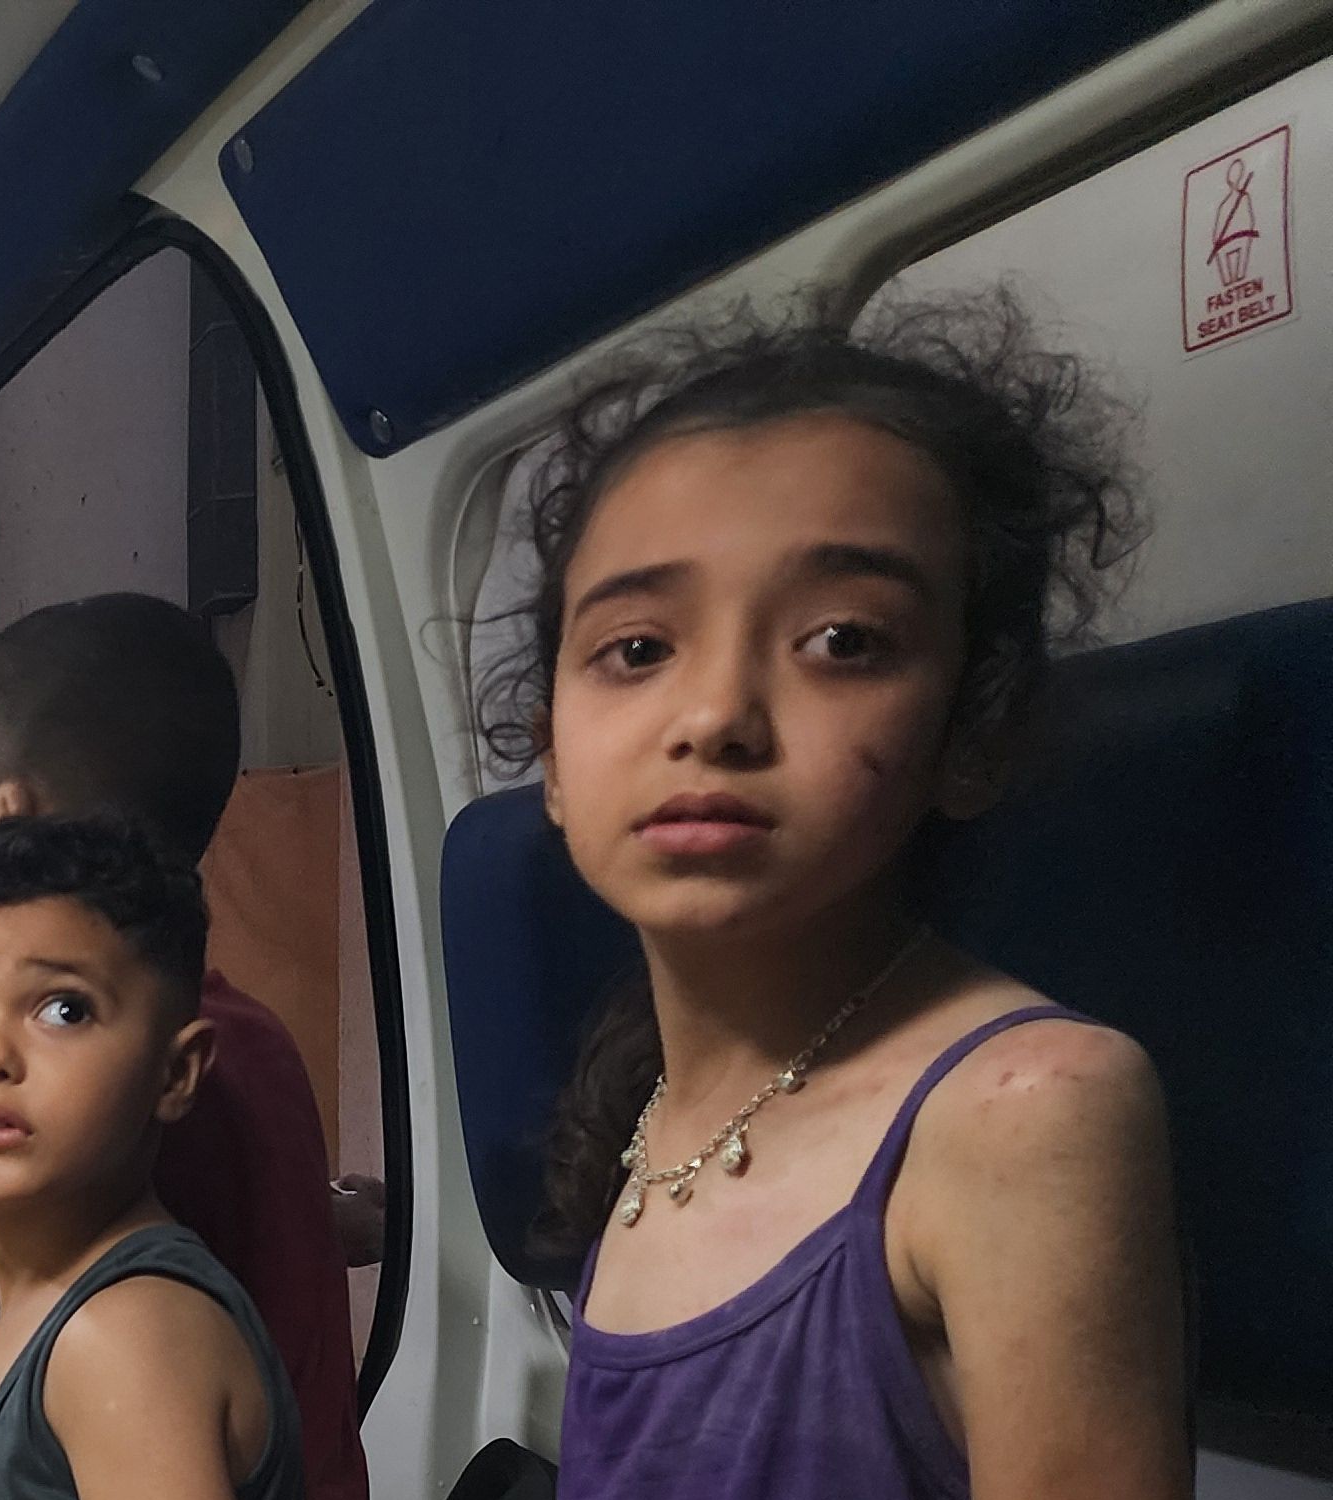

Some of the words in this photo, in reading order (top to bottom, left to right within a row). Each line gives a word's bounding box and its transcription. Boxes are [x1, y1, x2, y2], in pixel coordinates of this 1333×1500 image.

[1206, 278, 1263, 311] FASTEN
[1198, 311, 1234, 337] SEAT
[1238, 296, 1275, 322] BELT
